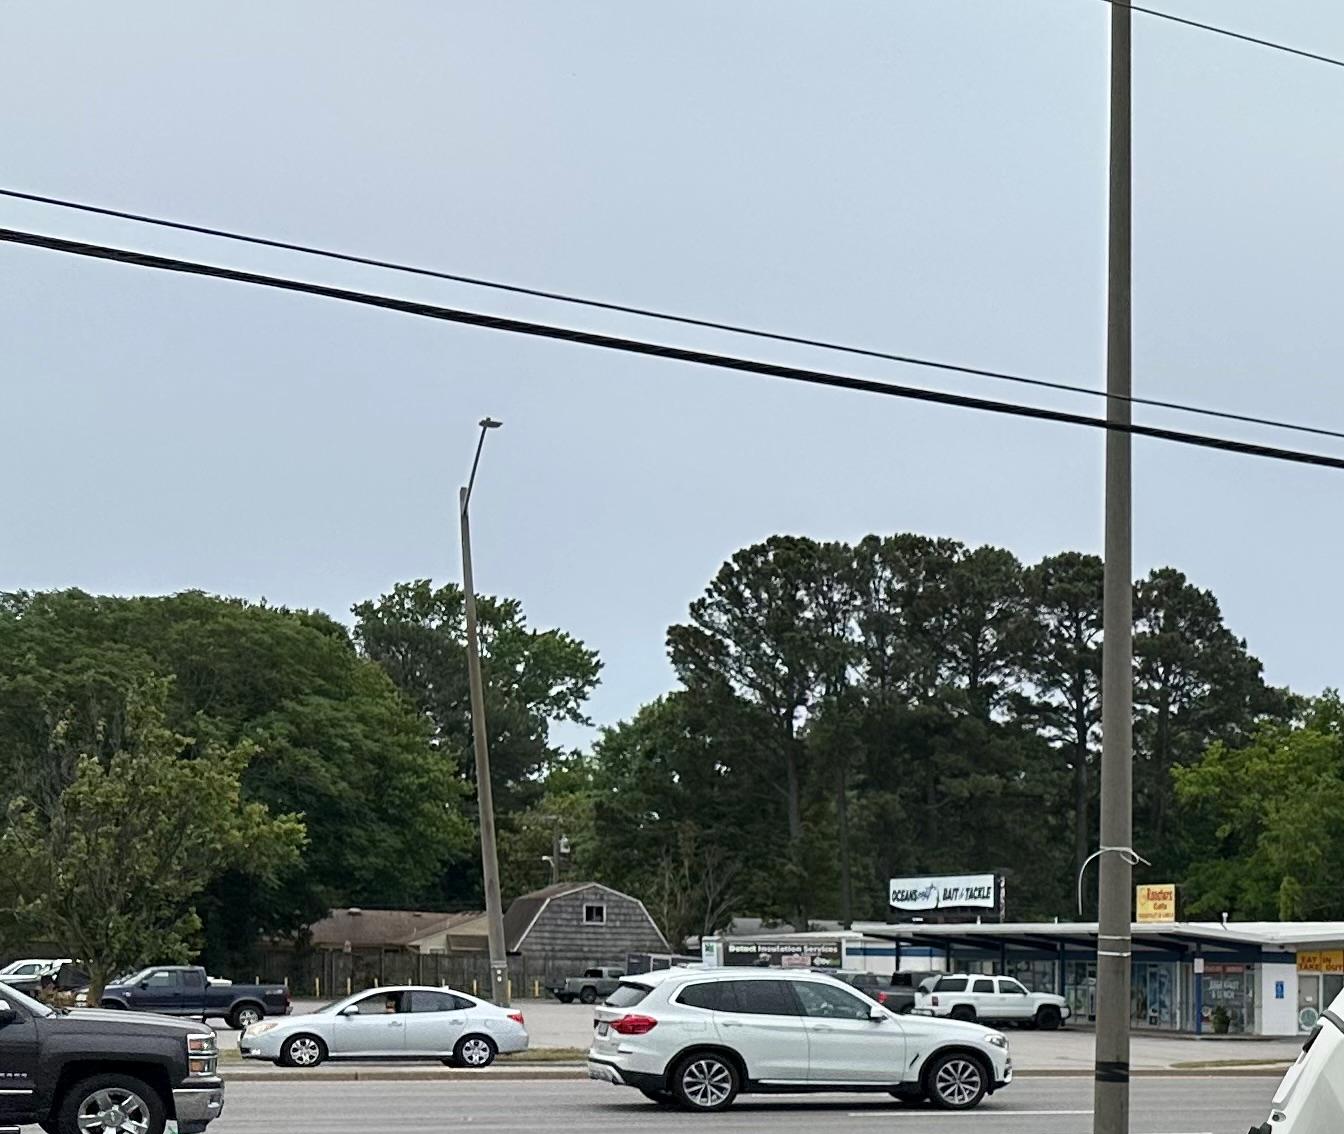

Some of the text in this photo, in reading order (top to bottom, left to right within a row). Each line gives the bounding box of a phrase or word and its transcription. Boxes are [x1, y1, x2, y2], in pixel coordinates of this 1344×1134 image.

[943, 887, 960, 901] BAIT
[965, 886, 992, 900] TACKLE
[758, 944, 802, 953] Insulation
[803, 944, 838, 954] Services
